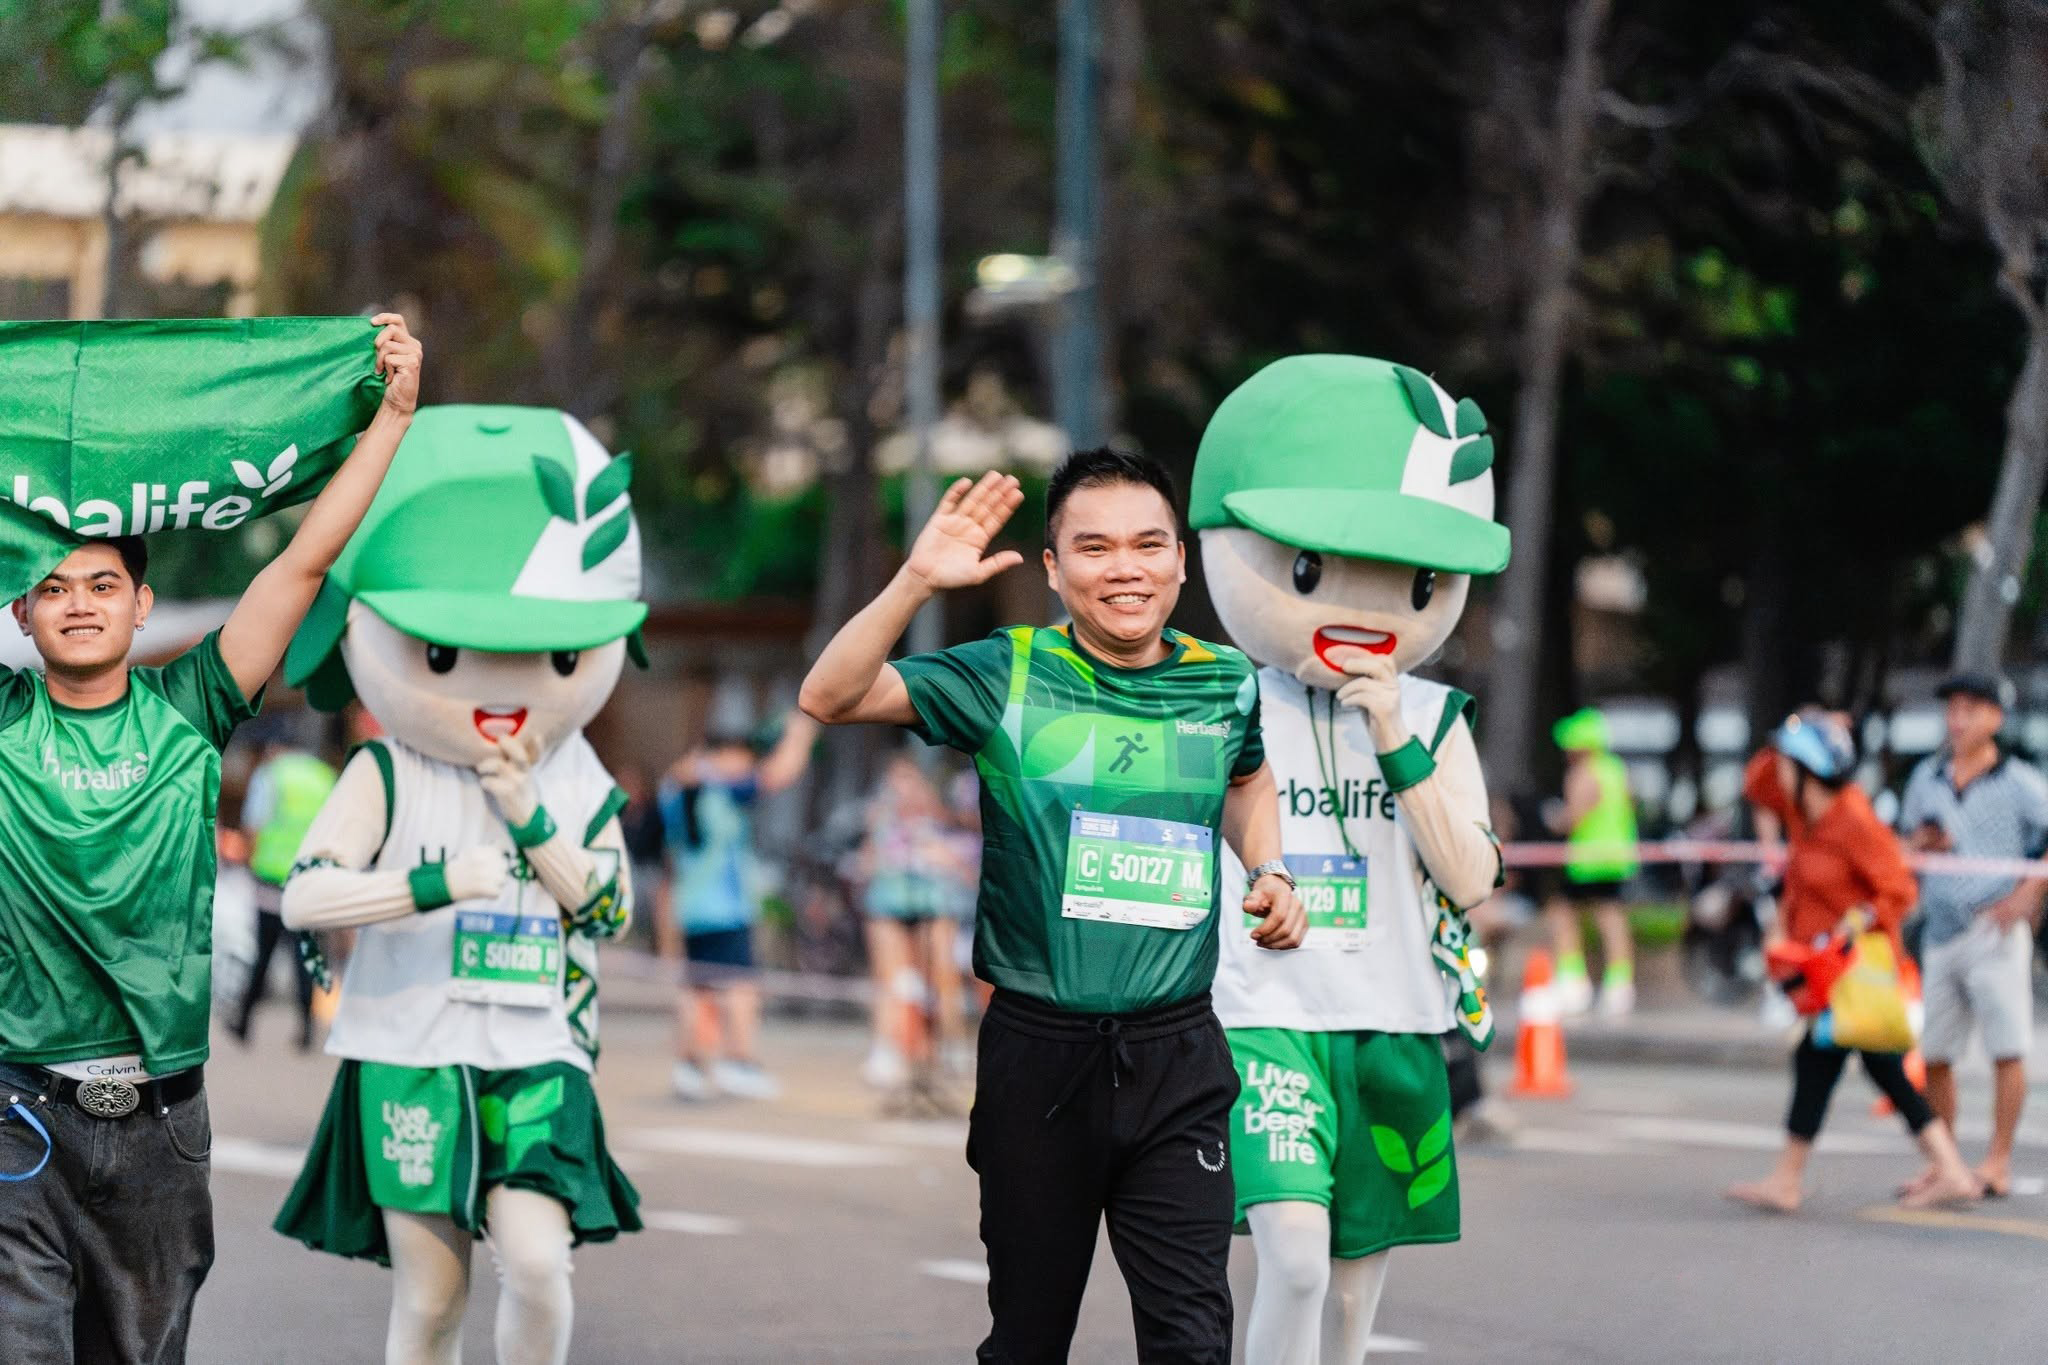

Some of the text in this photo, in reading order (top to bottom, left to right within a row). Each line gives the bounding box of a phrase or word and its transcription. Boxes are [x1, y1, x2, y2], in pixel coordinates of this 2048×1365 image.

[0, 476, 253, 538] balife
[1081, 850, 1204, 889] C 50127 M
[1342, 886, 1361, 913] M
[87, 1064, 136, 1076] Calvin
[1247, 1060, 1310, 1095] Live
[1269, 1131, 1317, 1164] life
